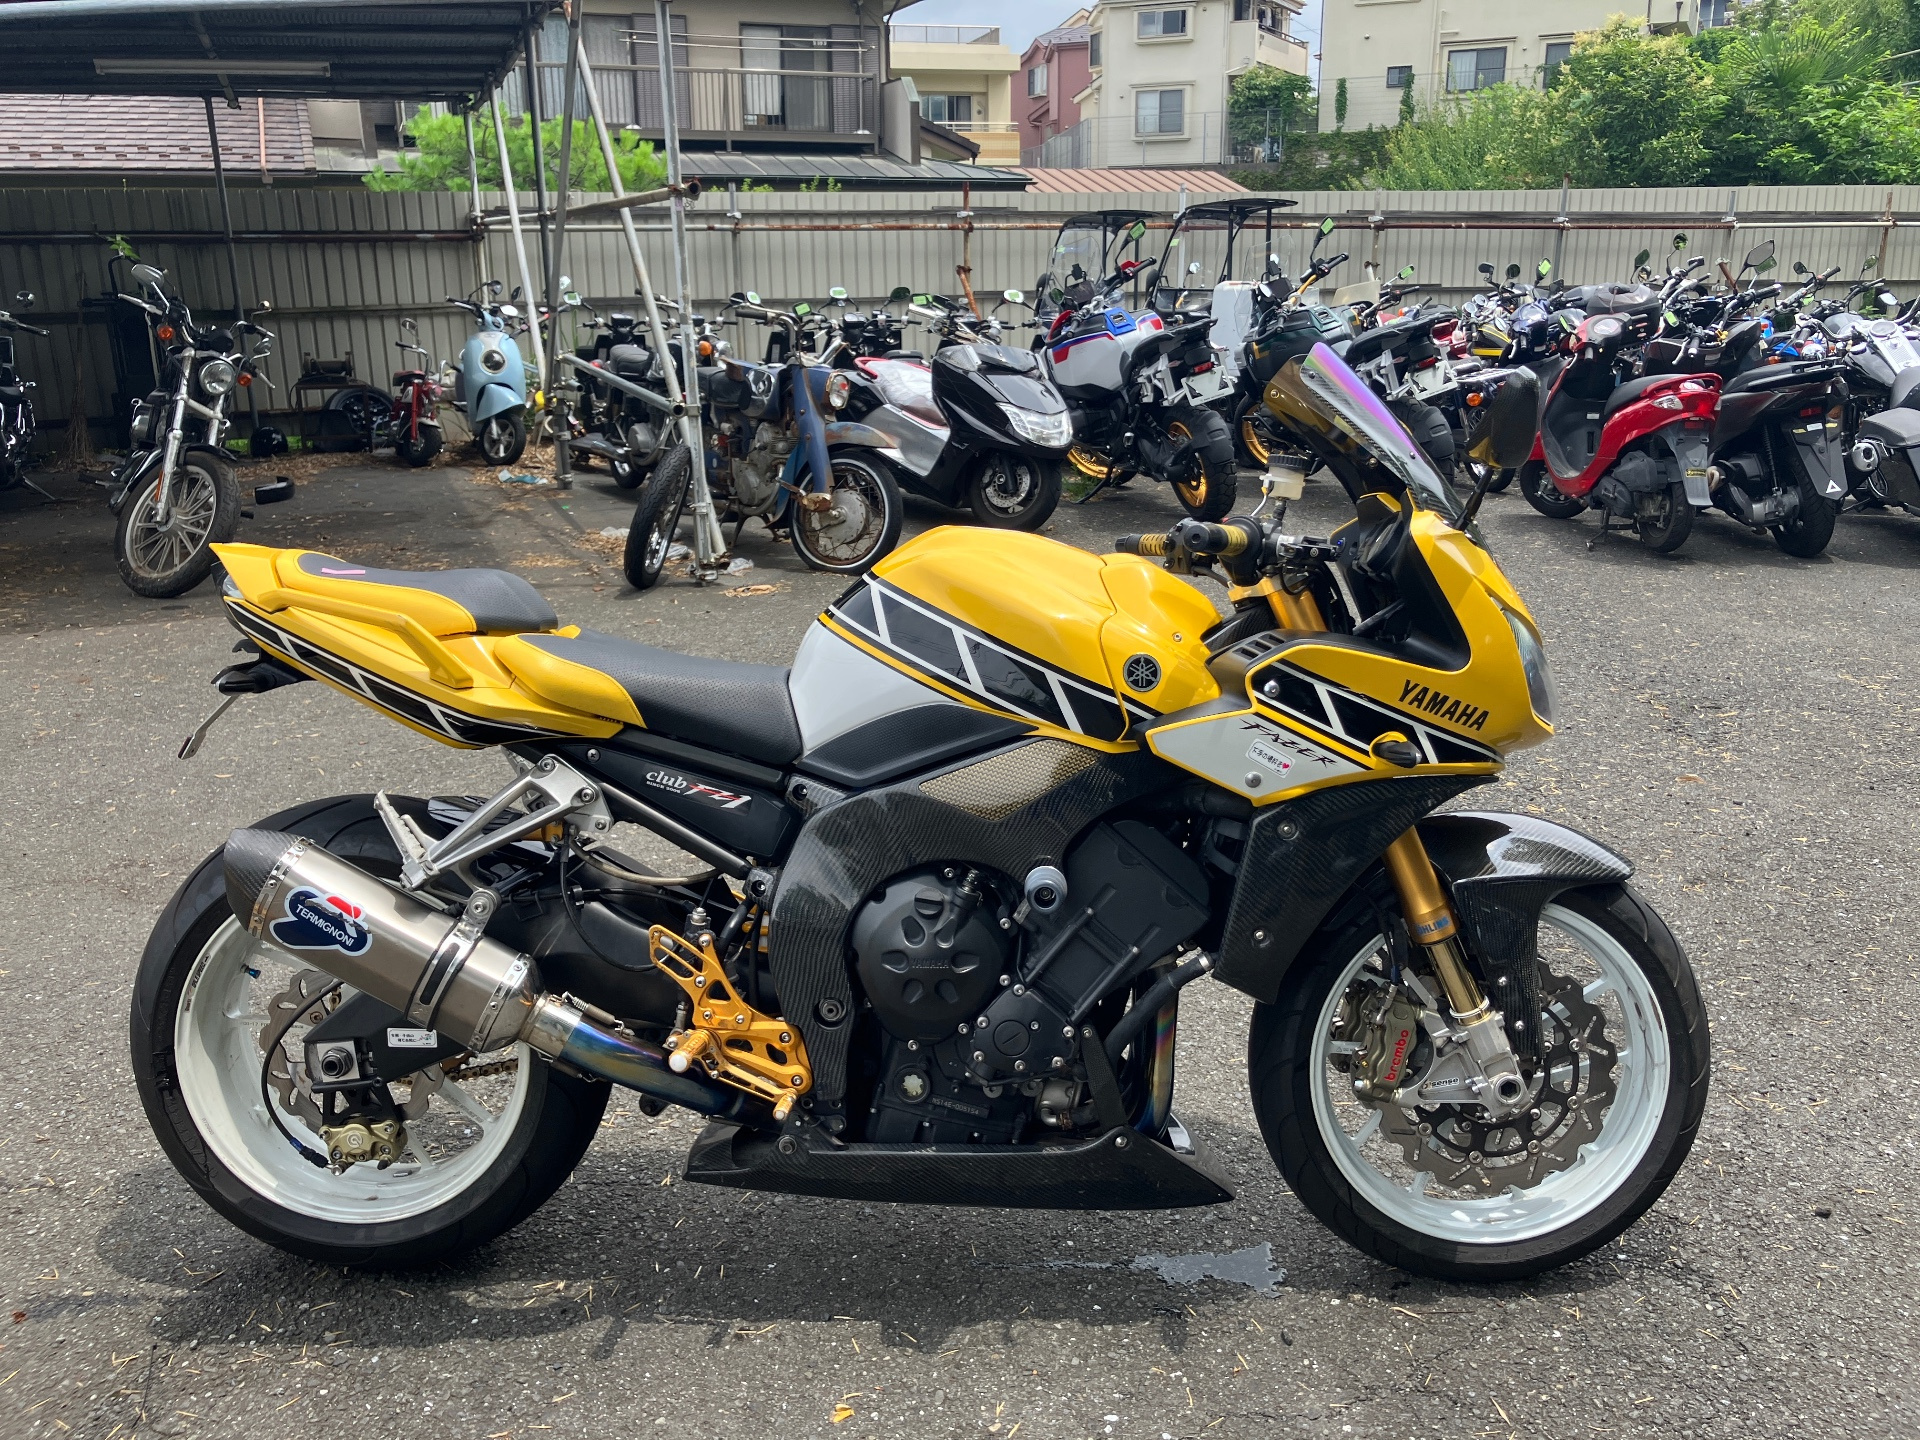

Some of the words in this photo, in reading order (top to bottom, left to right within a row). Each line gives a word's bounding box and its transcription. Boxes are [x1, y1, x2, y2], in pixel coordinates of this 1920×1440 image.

[1398, 679, 1490, 732] YAMAHA
[1239, 718, 1338, 768] FAZER
[646, 771, 687, 789] club
[296, 904, 355, 946] TERMIGNONI
[1384, 1029, 1409, 1081] brembo
